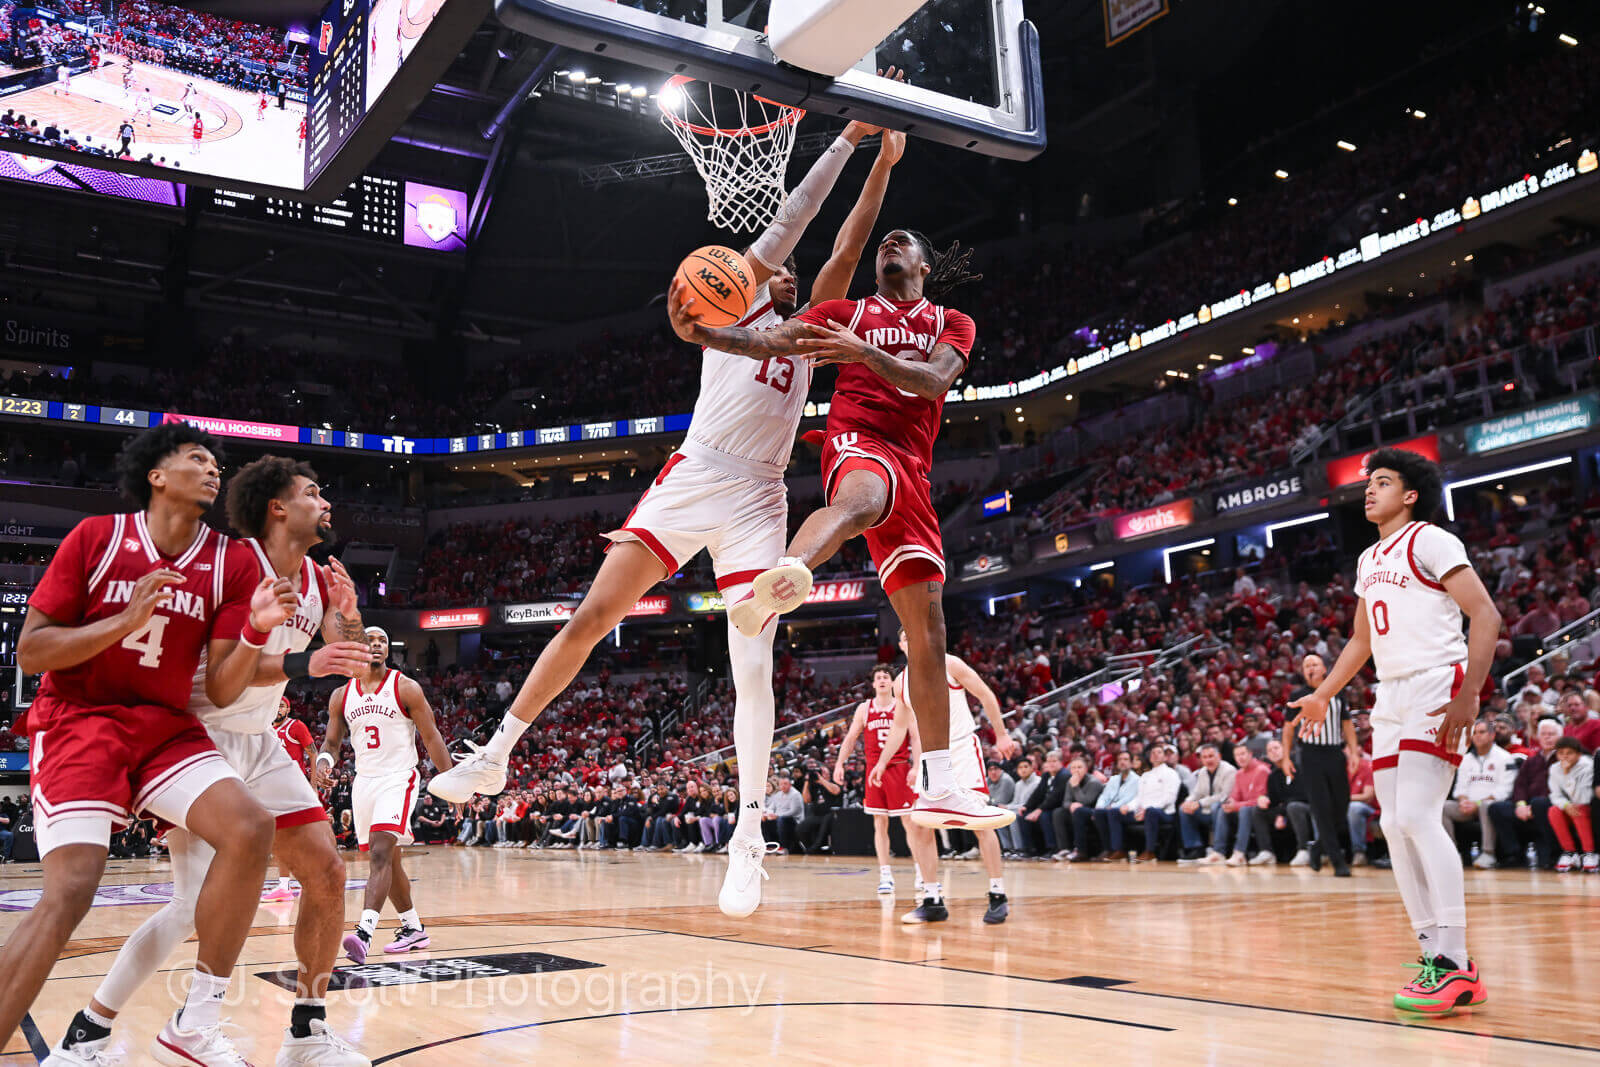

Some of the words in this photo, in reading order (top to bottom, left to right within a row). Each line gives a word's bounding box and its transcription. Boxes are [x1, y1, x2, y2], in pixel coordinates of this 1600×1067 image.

[1480, 174, 1540, 213] DRAKE'S
[1380, 217, 1431, 253] DRAKE'S
[708, 247, 750, 289] Wilson
[696, 267, 732, 299] NCAA
[5, 320, 70, 348] Spirits
[754, 356, 796, 395] 13
[70, 409, 79, 420] 2
[114, 410, 135, 425] 44
[1481, 414, 1524, 436] Peyton
[1524, 400, 1580, 424] Manning
[1534, 410, 1591, 434] Hospital
[182, 419, 226, 432] NDIANA
[228, 423, 282, 438] HOOSIERS
[1216, 477, 1302, 511] AMBROSE
[1144, 508, 1175, 529] mhs
[0, 525, 34, 536] IGHT
[125, 538, 140, 552] 76
[2, 593, 28, 604] 12:23
[102, 580, 205, 622] INANA
[805, 583, 837, 602] CAS
[839, 582, 865, 599] OIL
[505, 607, 552, 620] KeyBank
[635, 599, 668, 611] SHAKE
[1372, 600, 1390, 636] 0
[121, 614, 170, 669] 4
[346, 704, 397, 723] LOUISVILLE
[867, 718, 894, 731] INDIA
[364, 725, 381, 750] 3
[877, 729, 890, 750] 5
